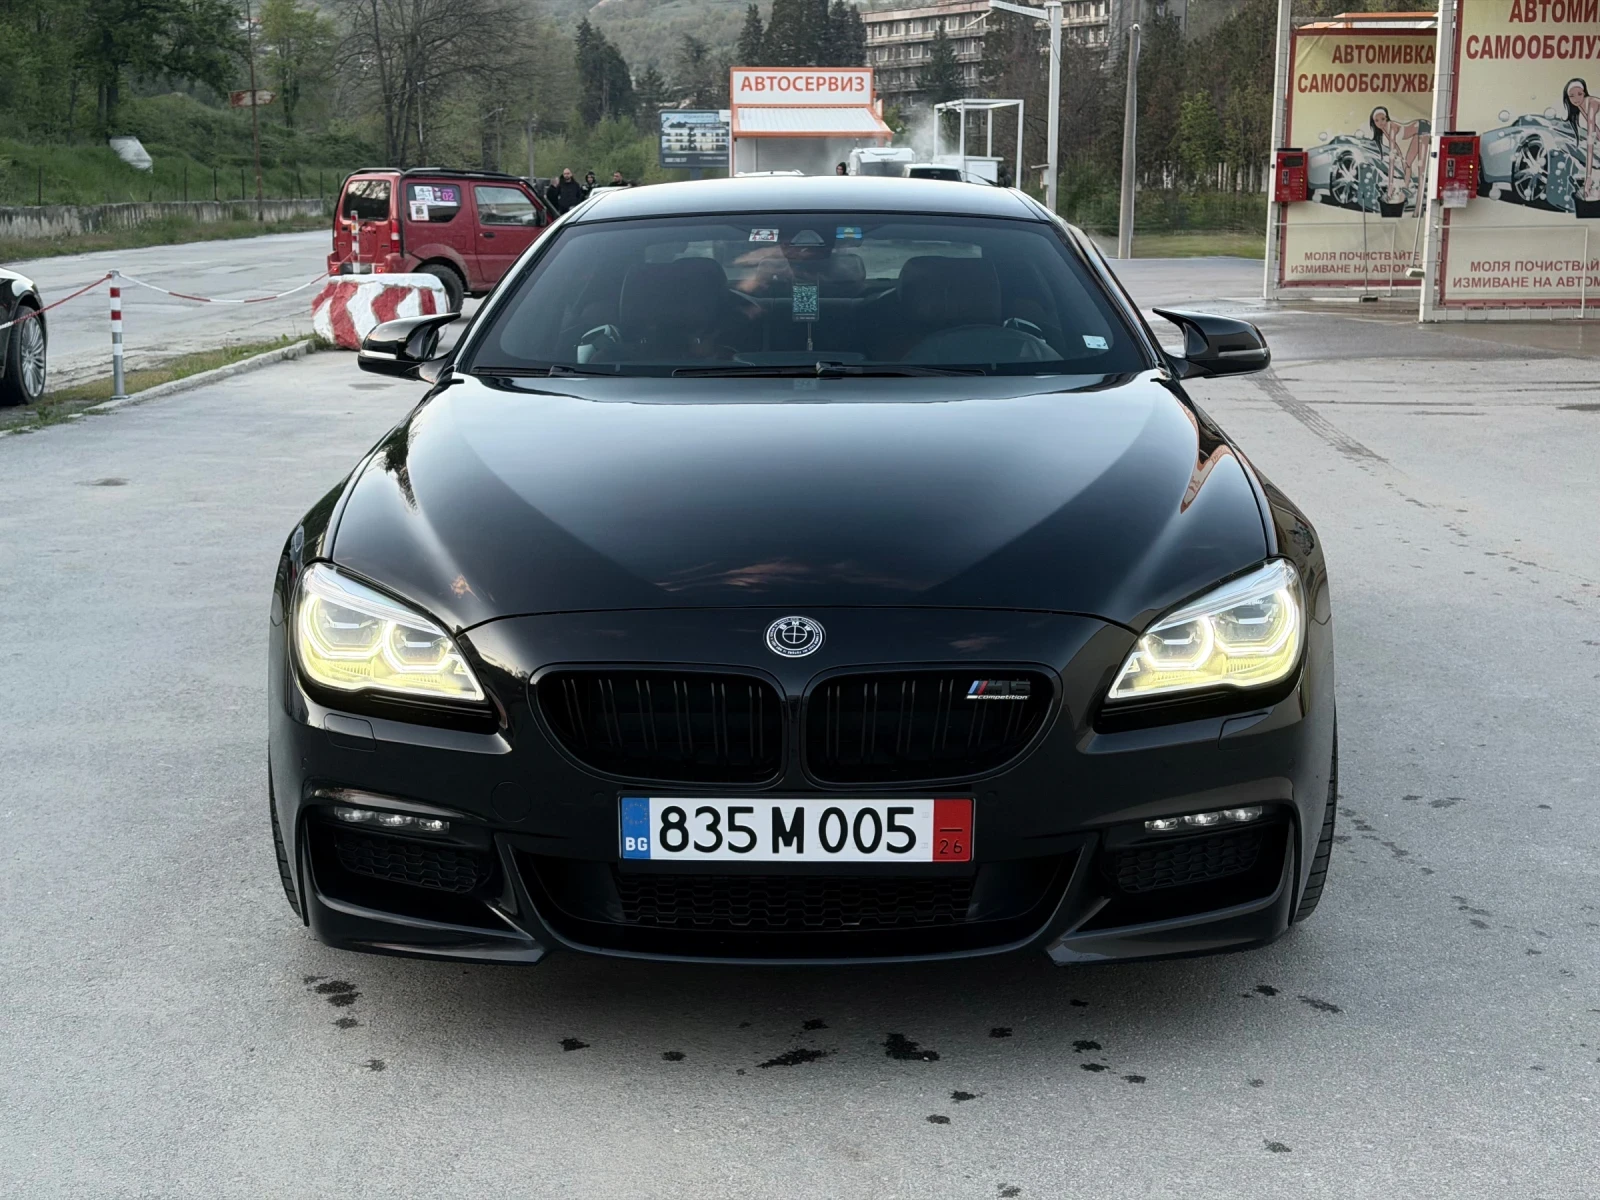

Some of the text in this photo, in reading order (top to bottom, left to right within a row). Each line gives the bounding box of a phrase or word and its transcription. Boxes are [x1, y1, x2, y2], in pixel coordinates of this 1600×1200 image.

[1508, 0, 1600, 23] АВТОМИ
[1331, 44, 1436, 65] АВТОМИВКА
[1465, 34, 1600, 60] САМООБСЛУ
[740, 75, 865, 92] АВТОСЕРВИЗ
[1304, 250, 1420, 262] МОЛЯ ПОЧИСТВАЙТЕ
[1290, 264, 1351, 274] ИЗМИВАНЕ
[1354, 264, 1367, 273] НА
[1470, 261, 1511, 272] МОЛЯ
[1453, 276, 1529, 288] ИЗМИВАНЕ
[1533, 277, 1552, 288] НА
[659, 805, 917, 855] 835 M 005
[625, 837, 648, 851] BG
[939, 839, 963, 855] 26
